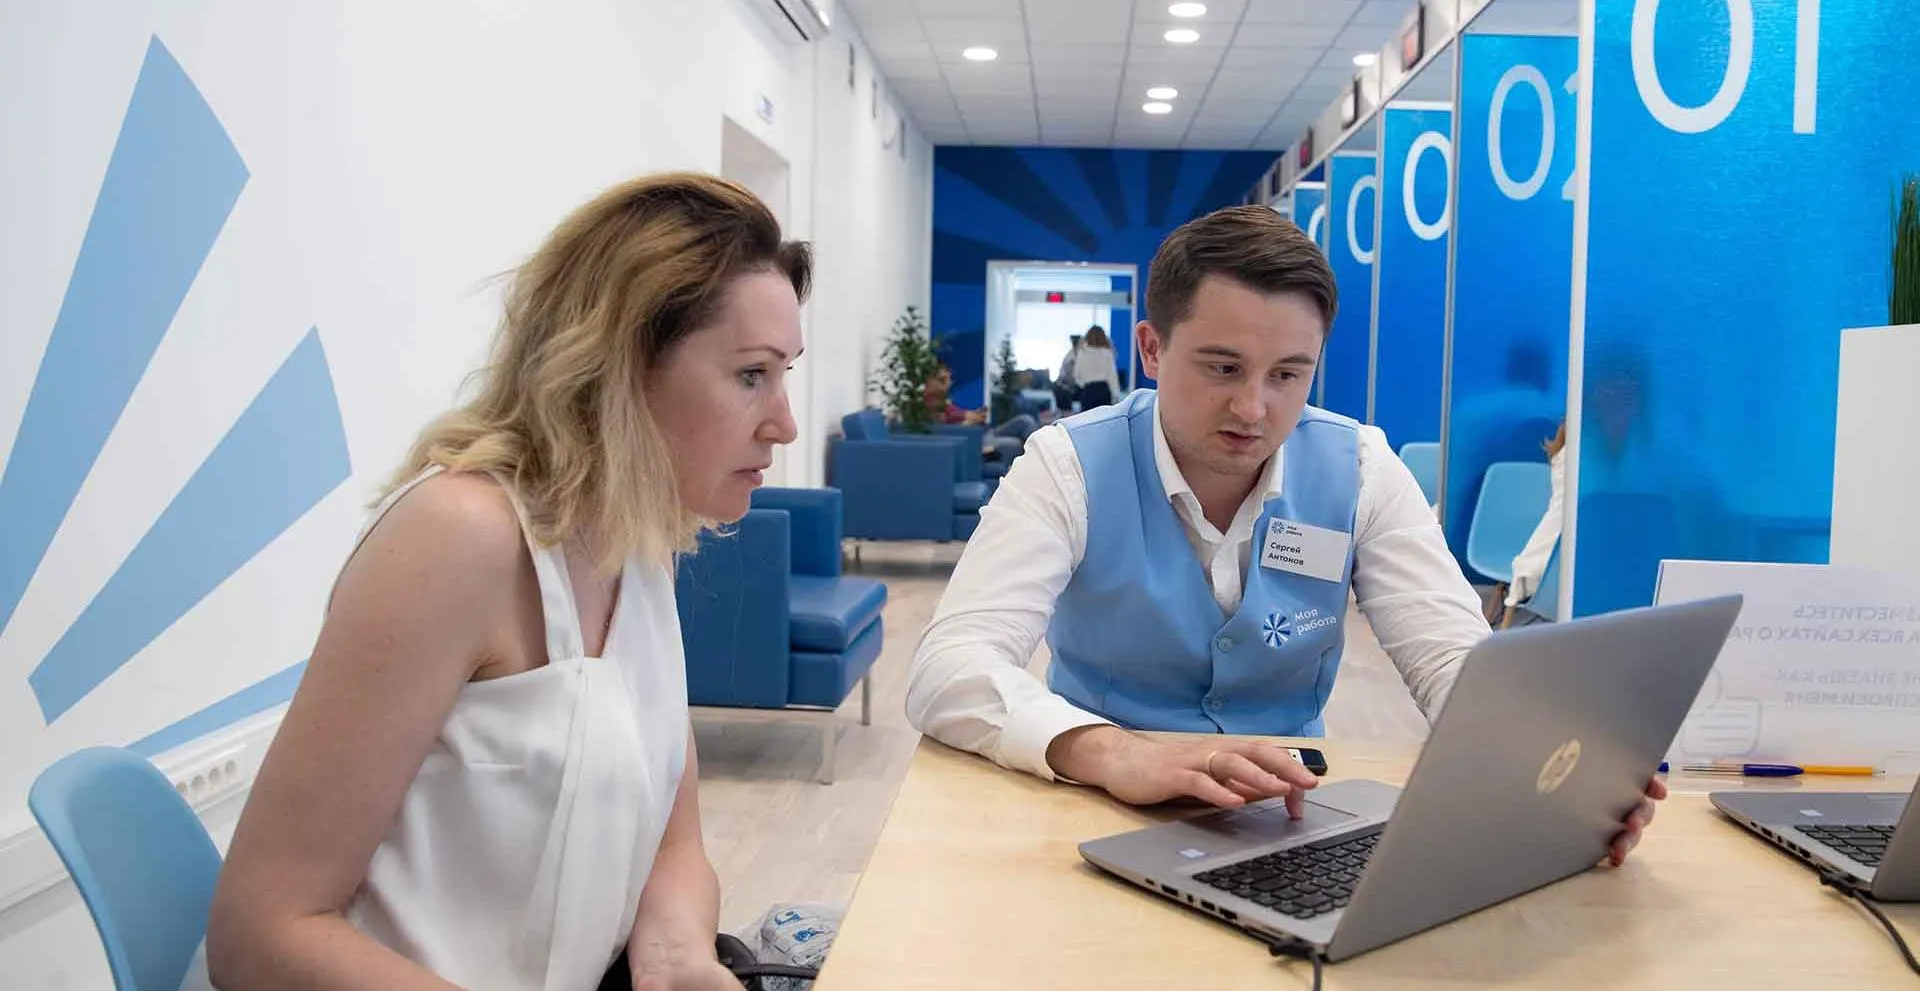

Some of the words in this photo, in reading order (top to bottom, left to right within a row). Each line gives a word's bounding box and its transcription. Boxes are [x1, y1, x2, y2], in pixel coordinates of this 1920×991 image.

[1631, 0, 1820, 134] 01
[1402, 131, 1450, 241] 0
[1346, 175, 1375, 264] 0
[1270, 541, 1301, 554] Сергей
[1268, 553, 1304, 566] Антонов
[1295, 608, 1318, 621] Моя
[1296, 616, 1337, 635] работа
